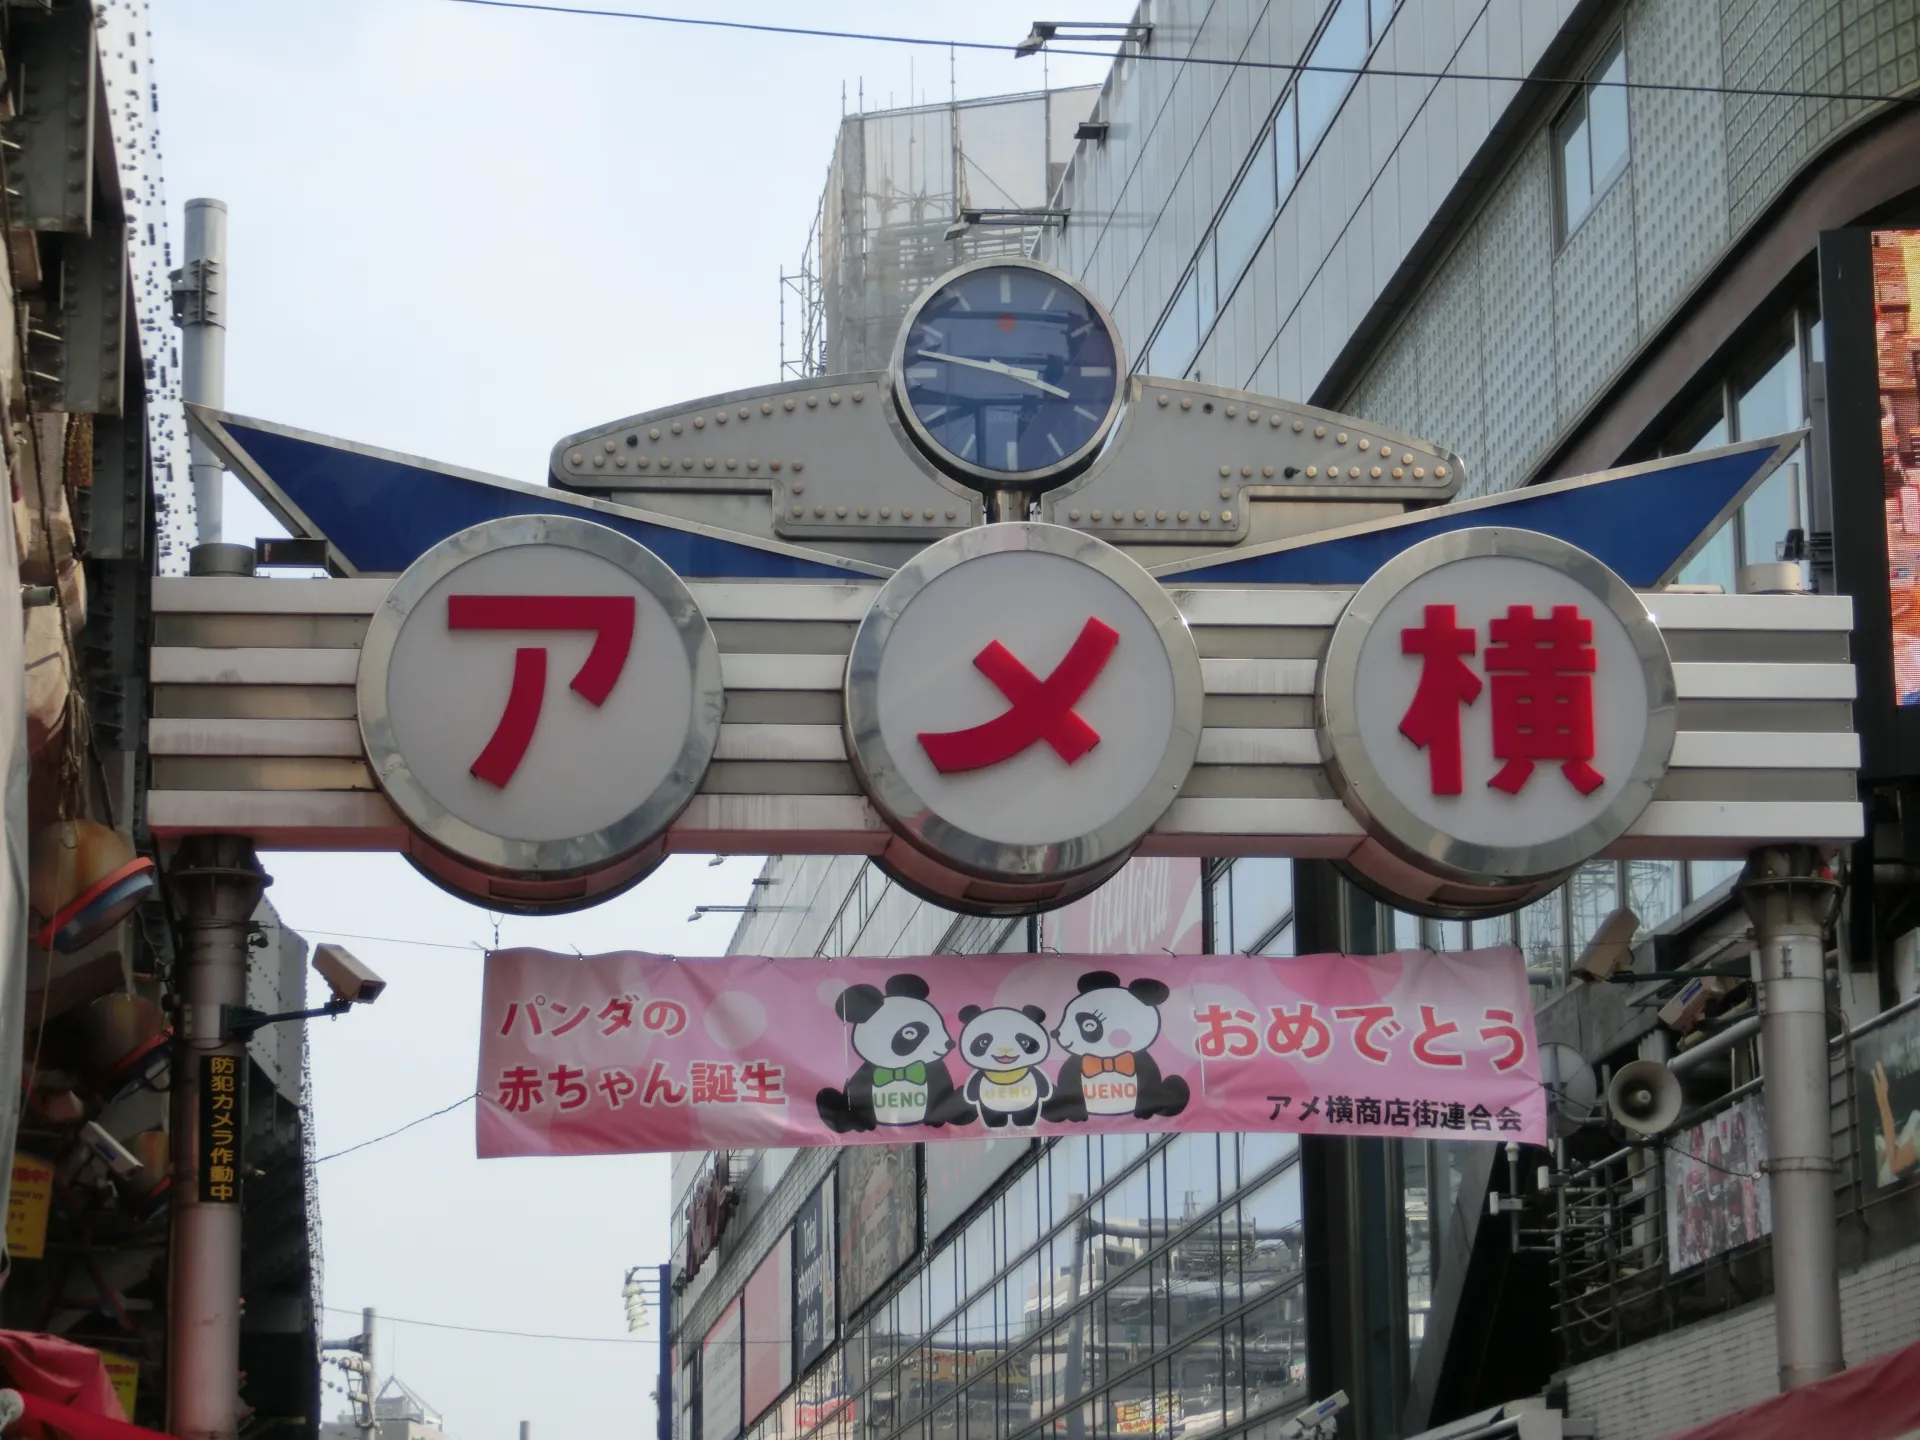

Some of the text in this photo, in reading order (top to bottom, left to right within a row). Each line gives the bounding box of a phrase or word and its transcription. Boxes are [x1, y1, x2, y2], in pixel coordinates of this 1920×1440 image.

[499, 994, 688, 1037] パンダの
[1194, 1003, 1526, 1071] おめでとう
[498, 1061, 786, 1113] 赤ちゃん誕生
[873, 1091, 928, 1109] UENO
[983, 1086, 1032, 1100] UENO
[1083, 1083, 1138, 1099] UENO
[210, 1056, 235, 1201] 防犯カメラ作動中
[1266, 1094, 1523, 1132] アメ横商店街連合会
